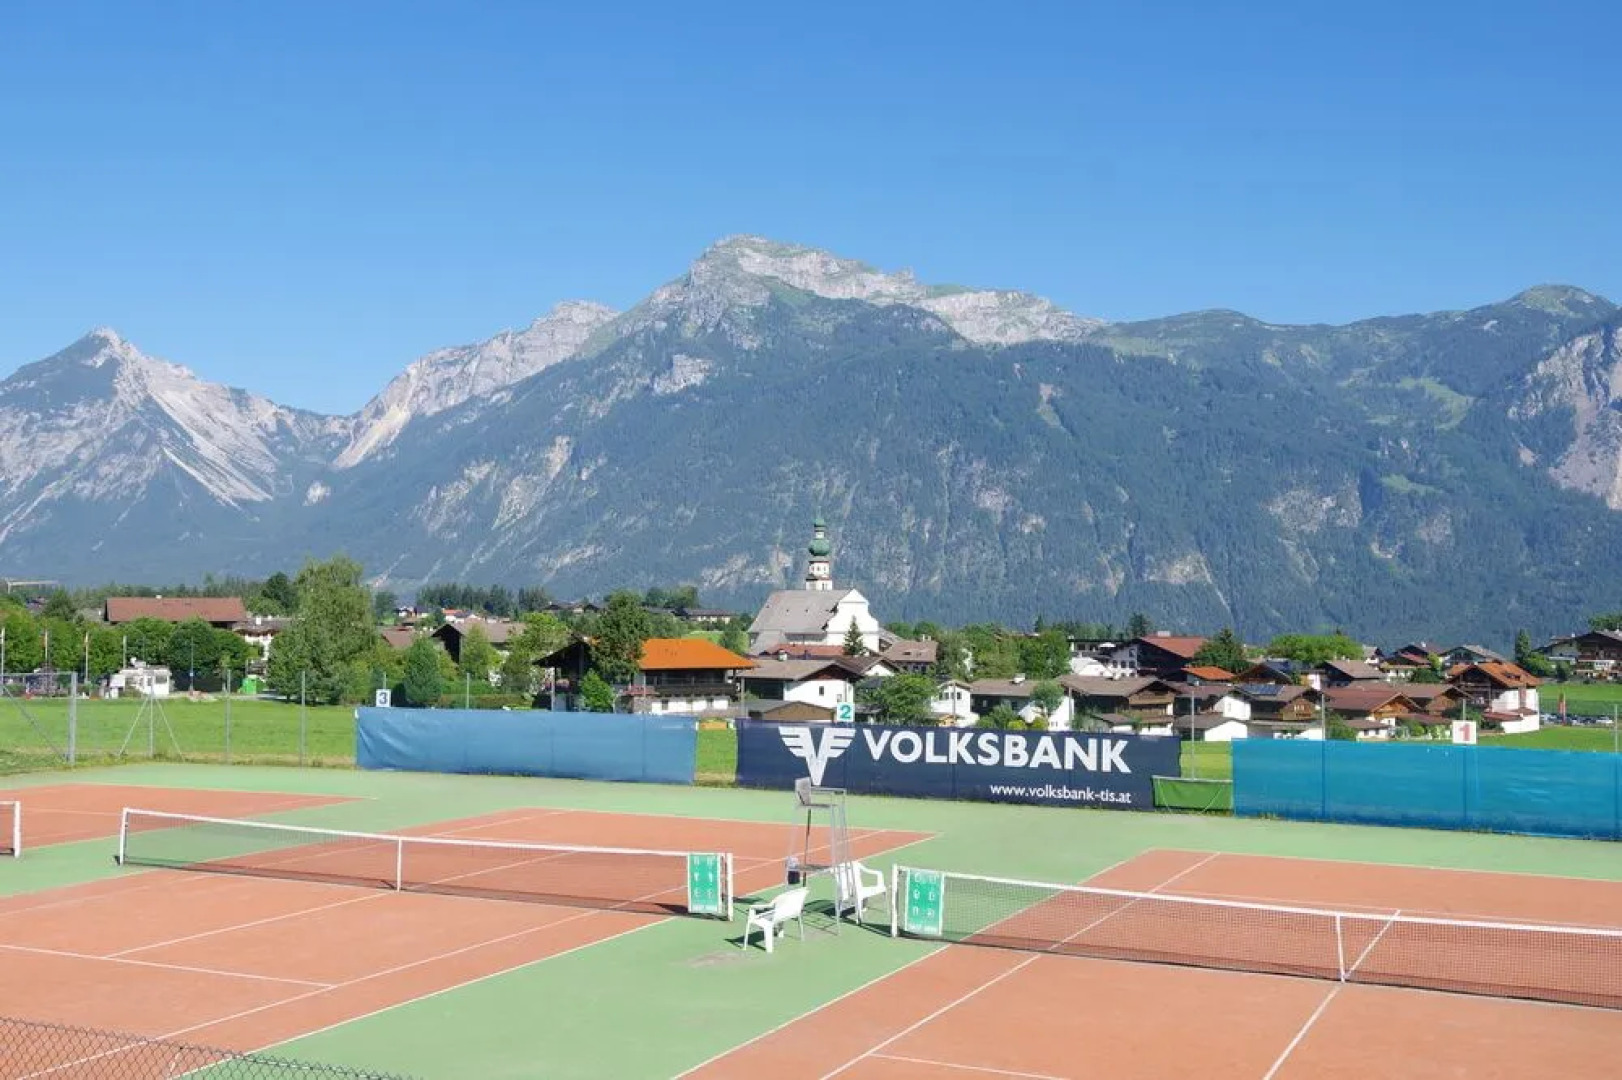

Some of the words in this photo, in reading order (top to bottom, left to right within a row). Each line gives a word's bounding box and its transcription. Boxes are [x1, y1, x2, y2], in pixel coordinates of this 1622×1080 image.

[379, 692, 387, 705] 3
[840, 705, 851, 719] 2
[1459, 723, 1470, 741] 1
[863, 728, 1132, 773] VOLKSBANK
[990, 784, 1132, 803] www.volksbank-tis.at
